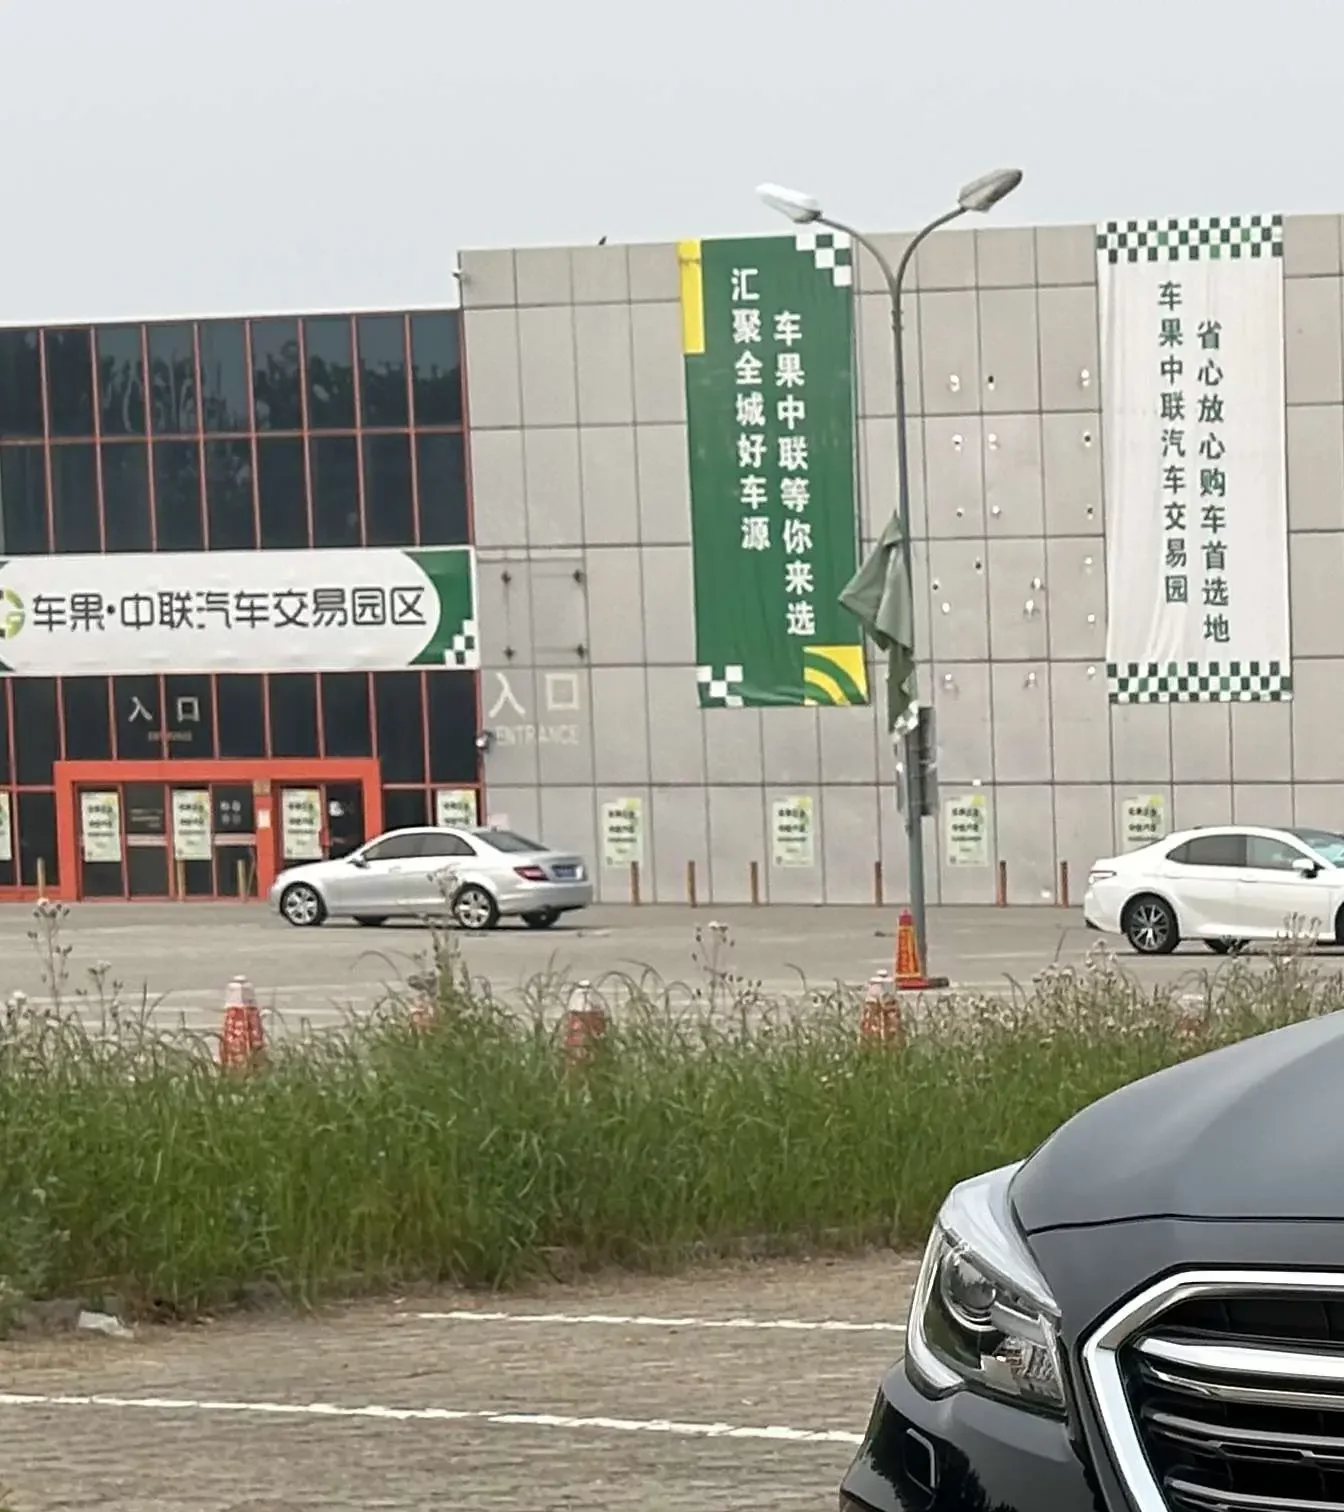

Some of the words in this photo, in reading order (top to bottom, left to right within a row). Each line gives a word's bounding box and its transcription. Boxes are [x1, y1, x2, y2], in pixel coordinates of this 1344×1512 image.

[730, 268, 771, 550] 汇聚全城好车源
[773, 310, 815, 635] 车果中联等你来选
[1158, 280, 1188, 604] 车果中联汽车交易园
[1197, 319, 1231, 643] 省心放心购车首选地
[127, 696, 200, 722] 入口
[488, 672, 580, 719] 入口
